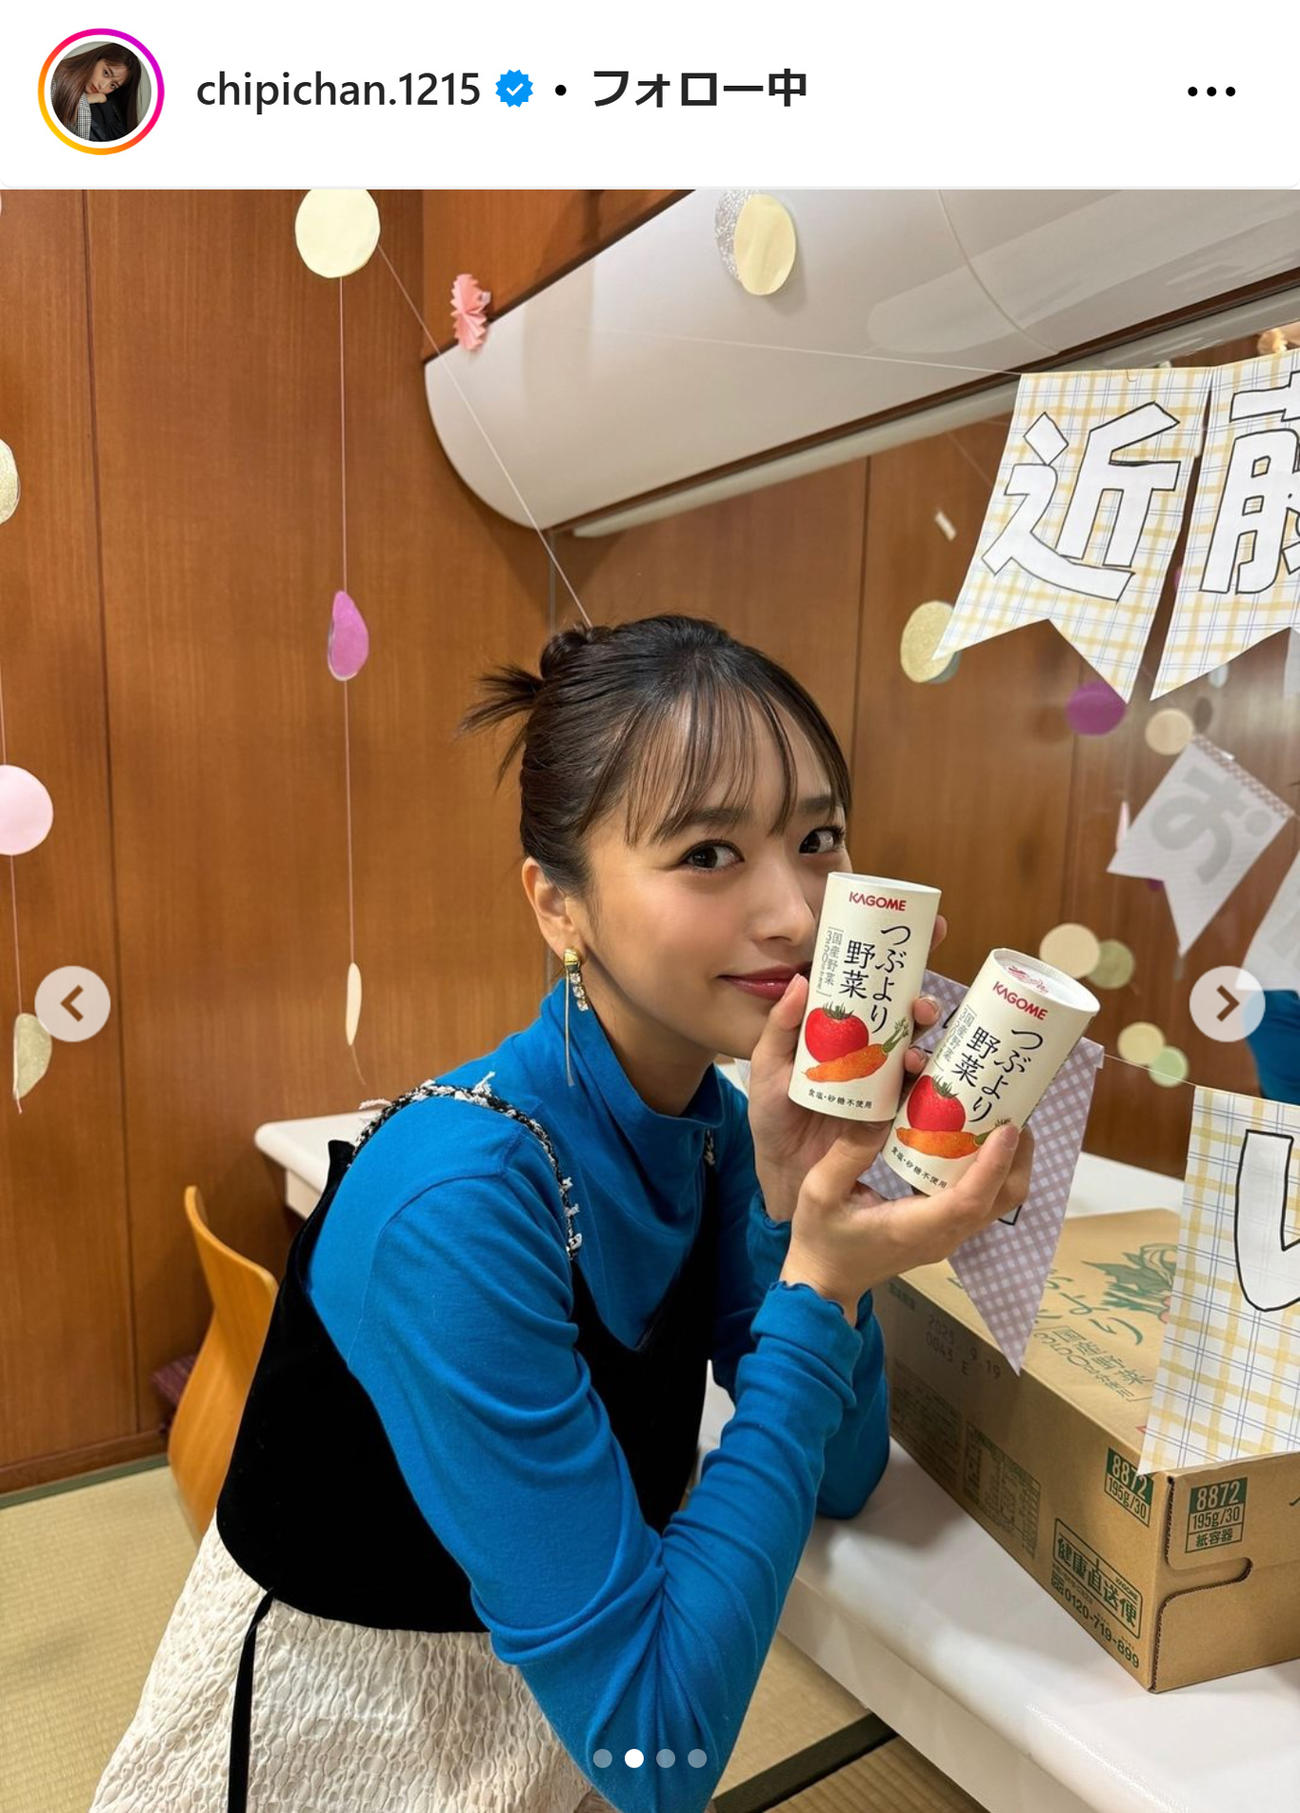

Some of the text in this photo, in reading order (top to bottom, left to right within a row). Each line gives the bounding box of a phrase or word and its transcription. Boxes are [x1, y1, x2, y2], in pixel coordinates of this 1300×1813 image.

[849, 891, 907, 912] KAGOME
[838, 939, 876, 999] 野菜
[869, 925, 912, 1034] つぶより
[992, 981, 1049, 1021] KAGOME
[951, 1026, 1001, 1088] 野菜
[968, 1028, 1044, 1123] つぶより
[1107, 1476, 1147, 1520] 195g/30
[1112, 1454, 1148, 1500] 8872
[1196, 1480, 1240, 1511] 8872
[1192, 1506, 1241, 1531] 195g/30
[1195, 1528, 1233, 1548] 紙容器
[1057, 1537, 1137, 1628] 健康直送便
[1064, 1586, 1140, 1669] 0120-719-899
